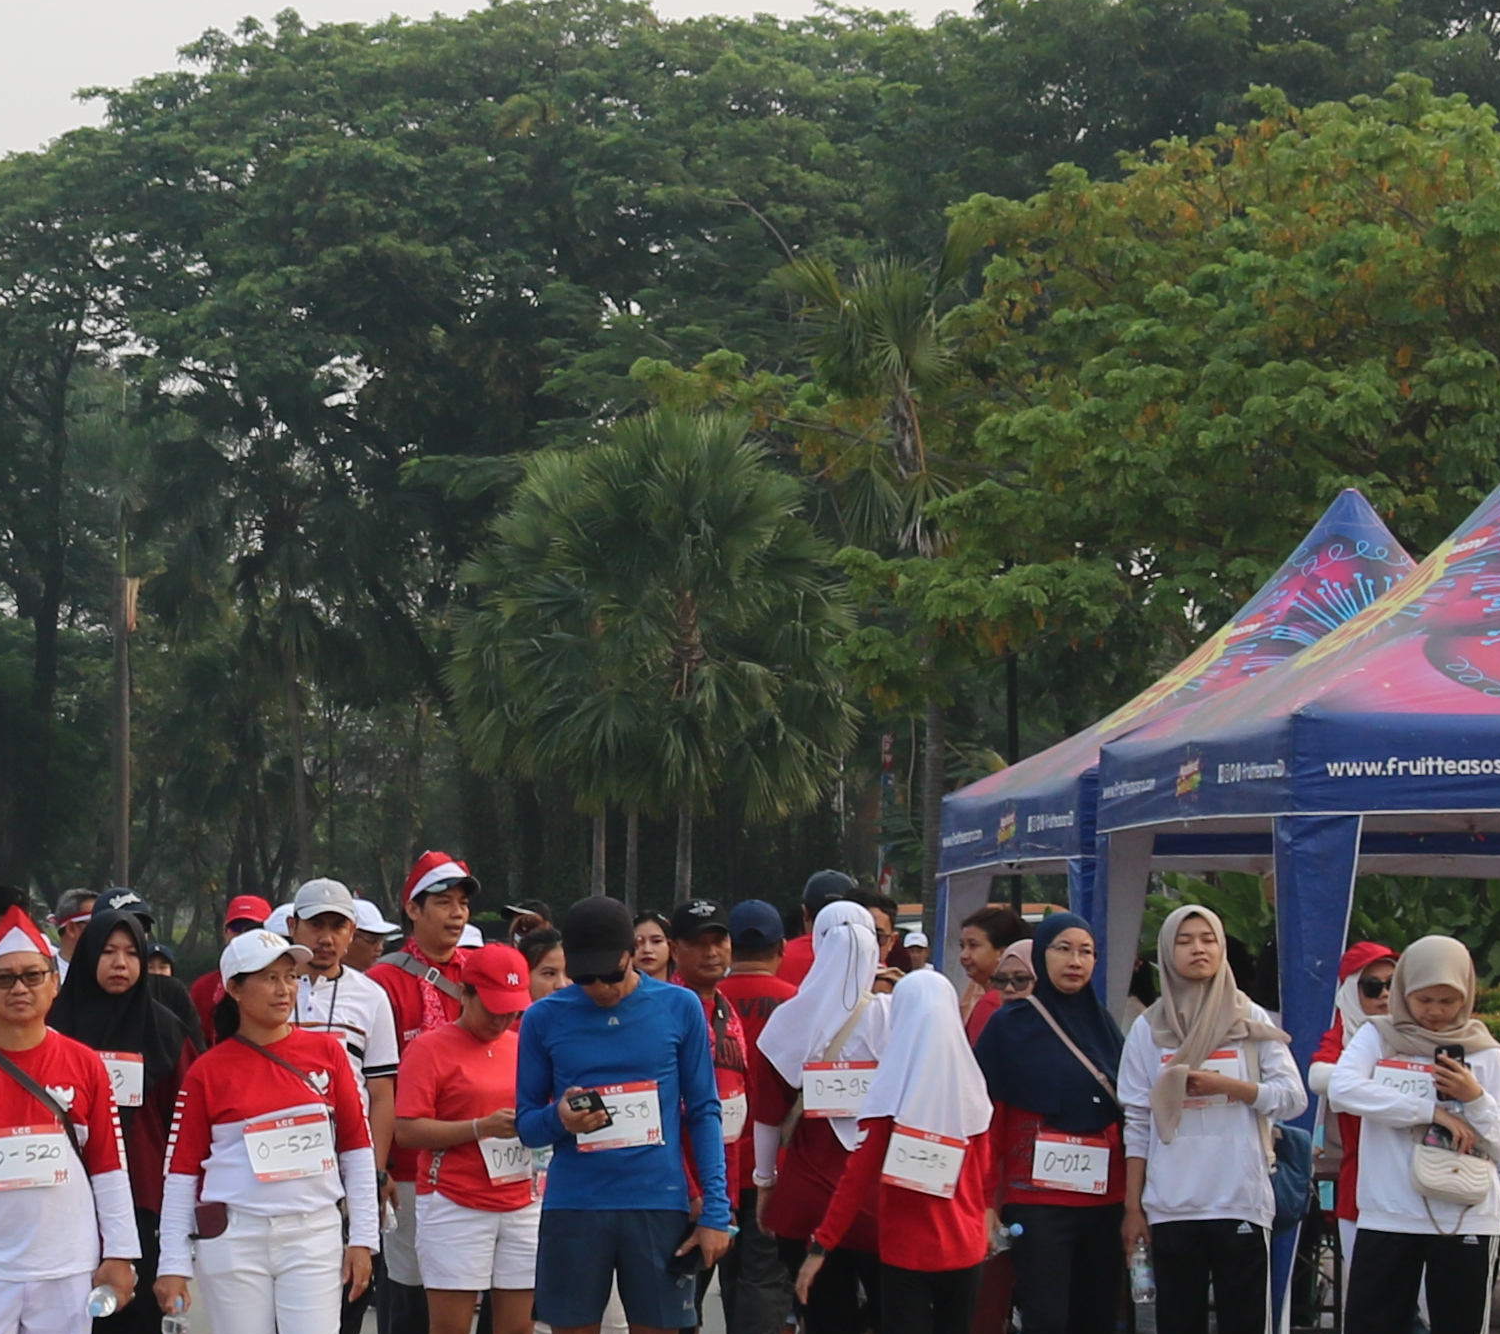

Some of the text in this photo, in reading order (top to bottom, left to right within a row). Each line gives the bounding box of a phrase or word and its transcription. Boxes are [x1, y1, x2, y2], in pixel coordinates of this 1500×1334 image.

[604, 1085, 623, 1094] LCC
[609, 1100, 650, 1119] 758
[276, 1118, 295, 1128] LCC
[11, 1126, 31, 1134] LCC
[1065, 1135, 1083, 1144] LCC
[256, 1132, 325, 1160] 0-522
[1043, 1150, 1093, 1173] 0-012
